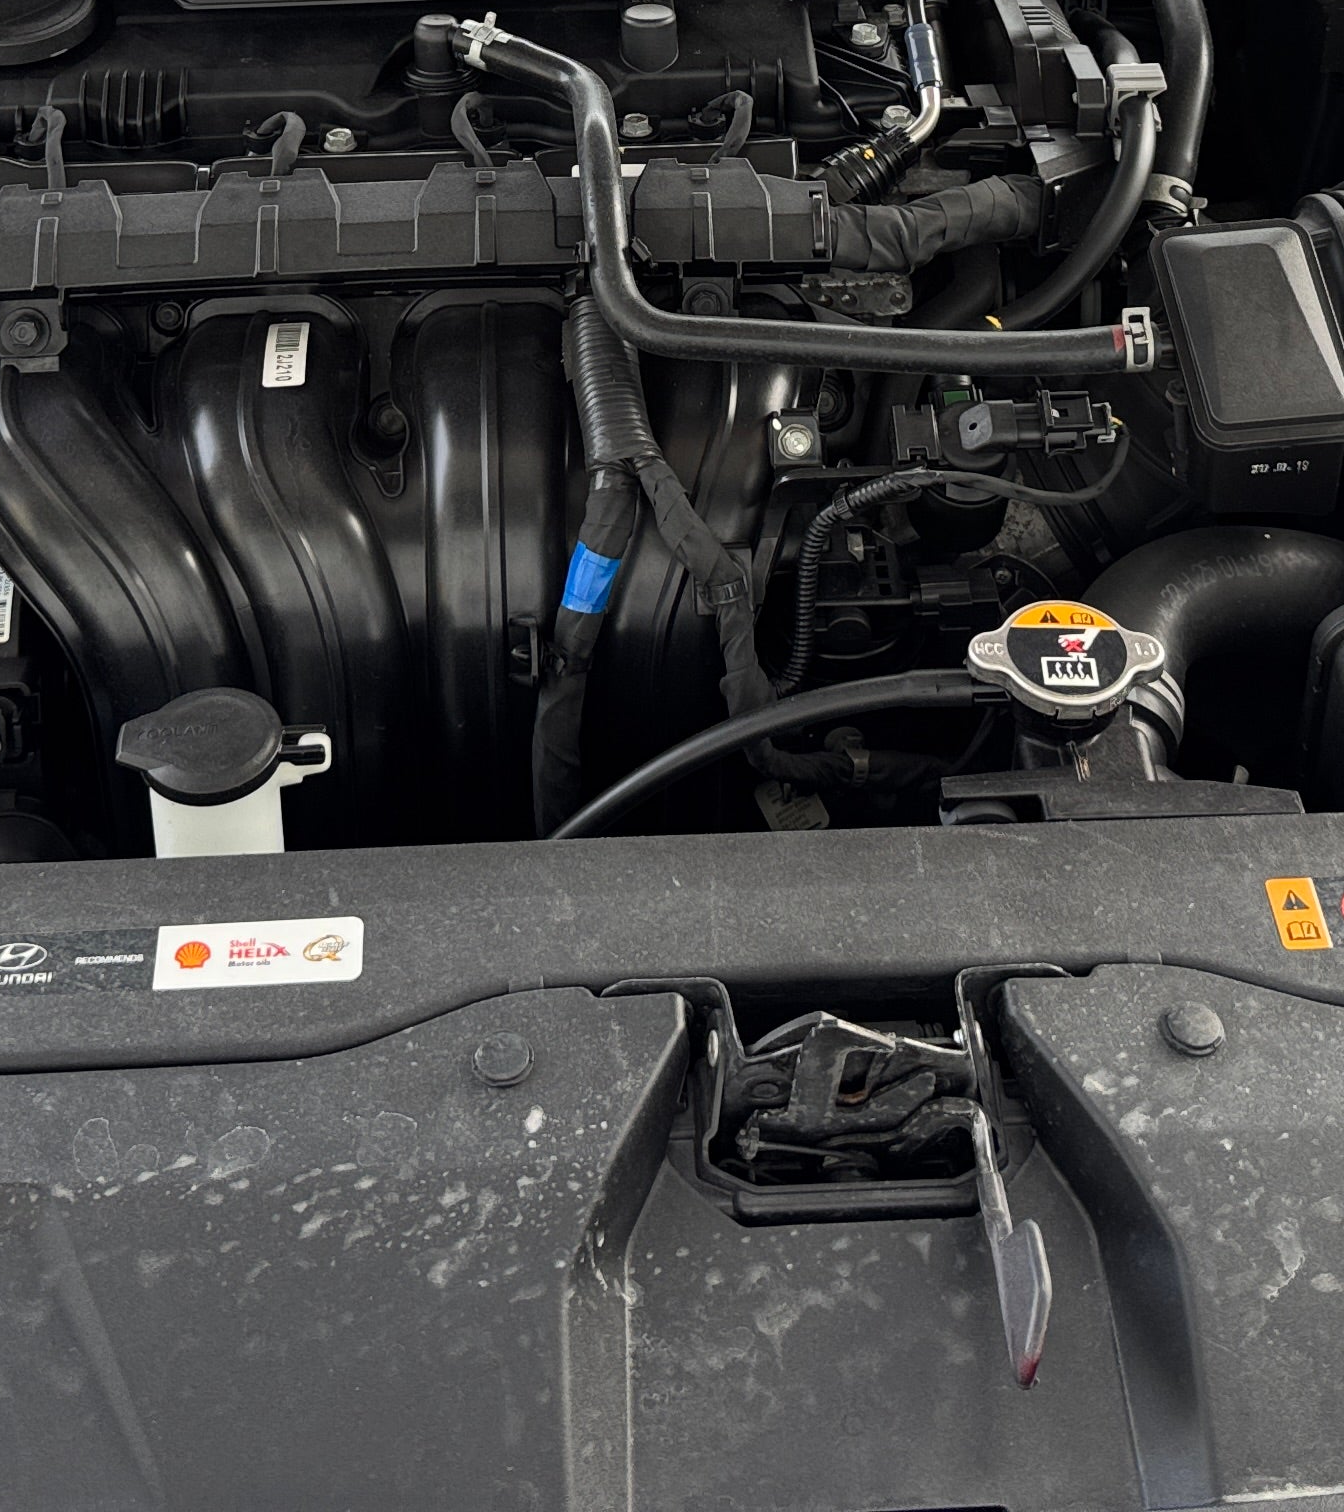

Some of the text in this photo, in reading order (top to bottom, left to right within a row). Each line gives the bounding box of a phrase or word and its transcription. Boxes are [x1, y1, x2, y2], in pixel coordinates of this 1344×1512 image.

[275, 354, 294, 382] 2J210
[973, 641, 1156, 656] HCC 1.1
[229, 937, 256, 948] Shell
[74, 952, 145, 966] RECOMMENDS
[228, 944, 291, 959] HELIX
